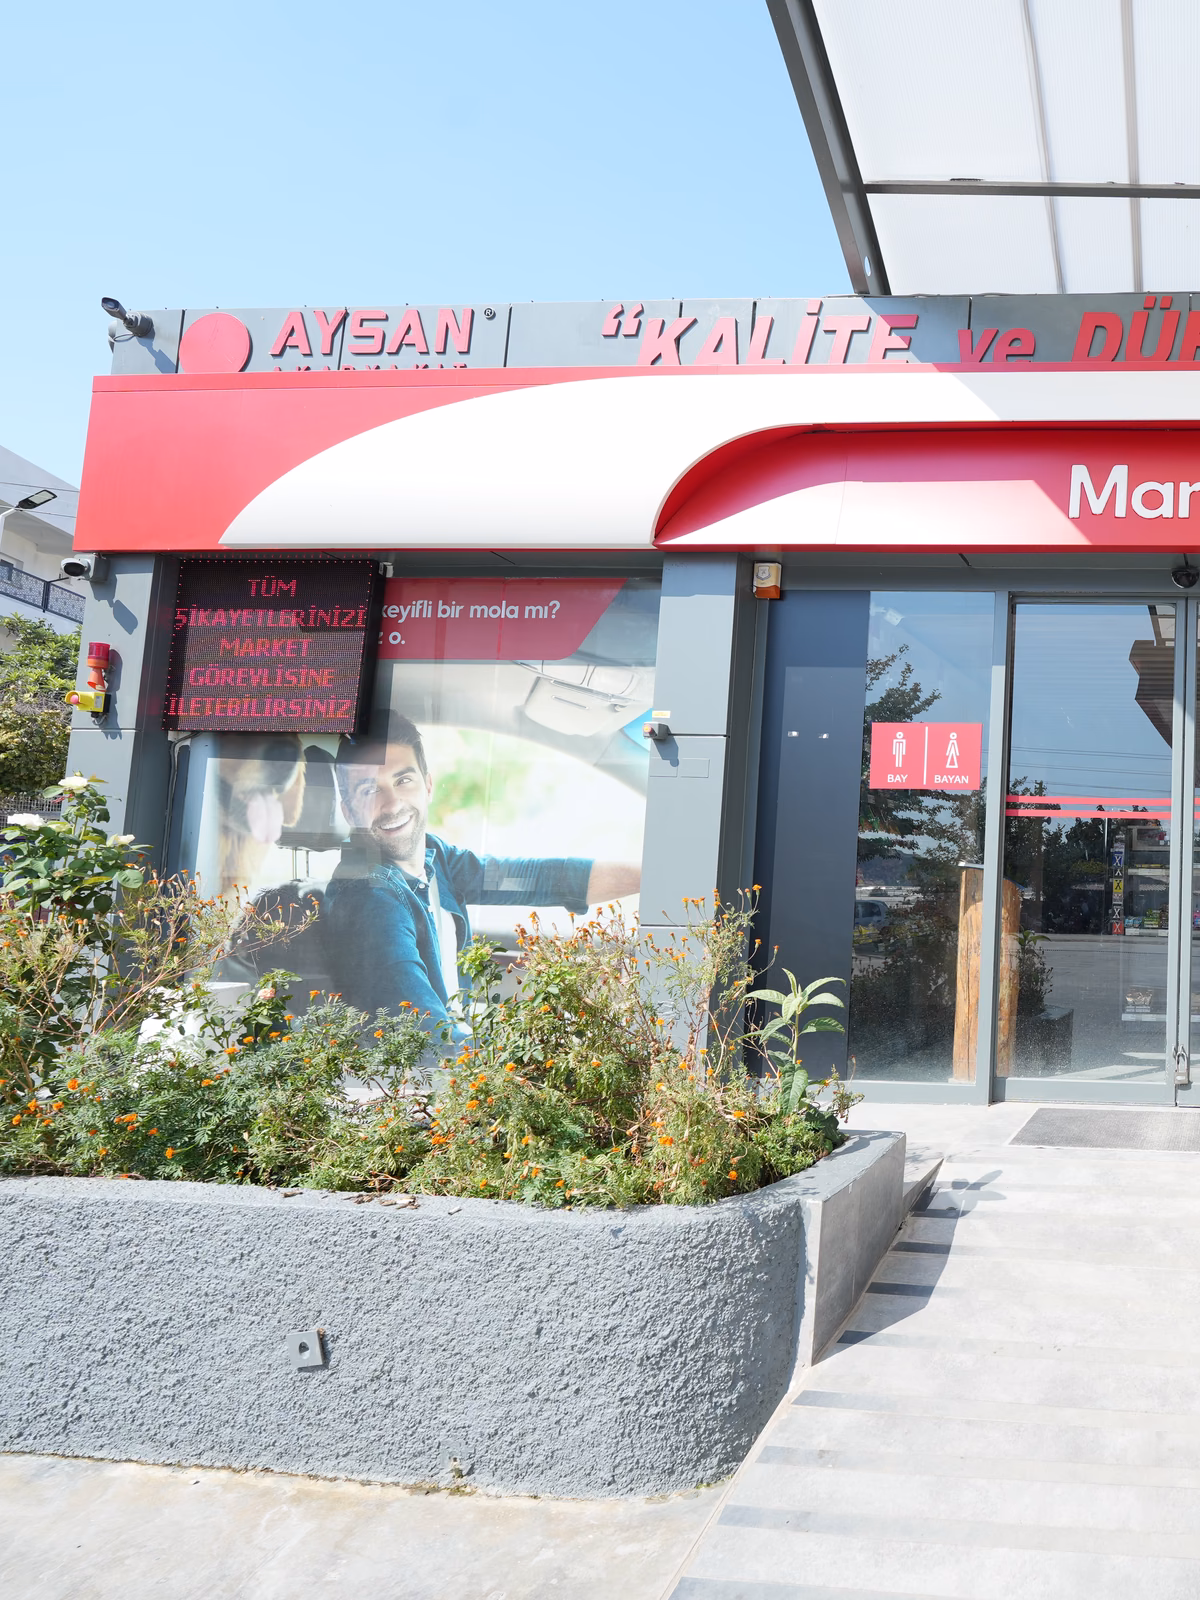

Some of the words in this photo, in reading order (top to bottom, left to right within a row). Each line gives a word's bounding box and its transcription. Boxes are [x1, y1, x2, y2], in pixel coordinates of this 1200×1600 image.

[269, 307, 474, 355] AYSAN
[957, 328, 1036, 363] ve
[248, 576, 297, 597] TÜM
[174, 604, 367, 630] ŞİKAYETLERİNİZİ
[437, 600, 464, 618] bir
[470, 600, 519, 619] mola
[525, 600, 561, 619] mı?
[219, 638, 313, 657] MARKET
[389, 631, 406, 645] o.
[189, 664, 336, 687] GÖREVLİSİNE
[167, 694, 352, 718] İLETEBİLİRSİNİZ
[887, 774, 908, 783] BAY
[934, 774, 969, 784] BAYAN
